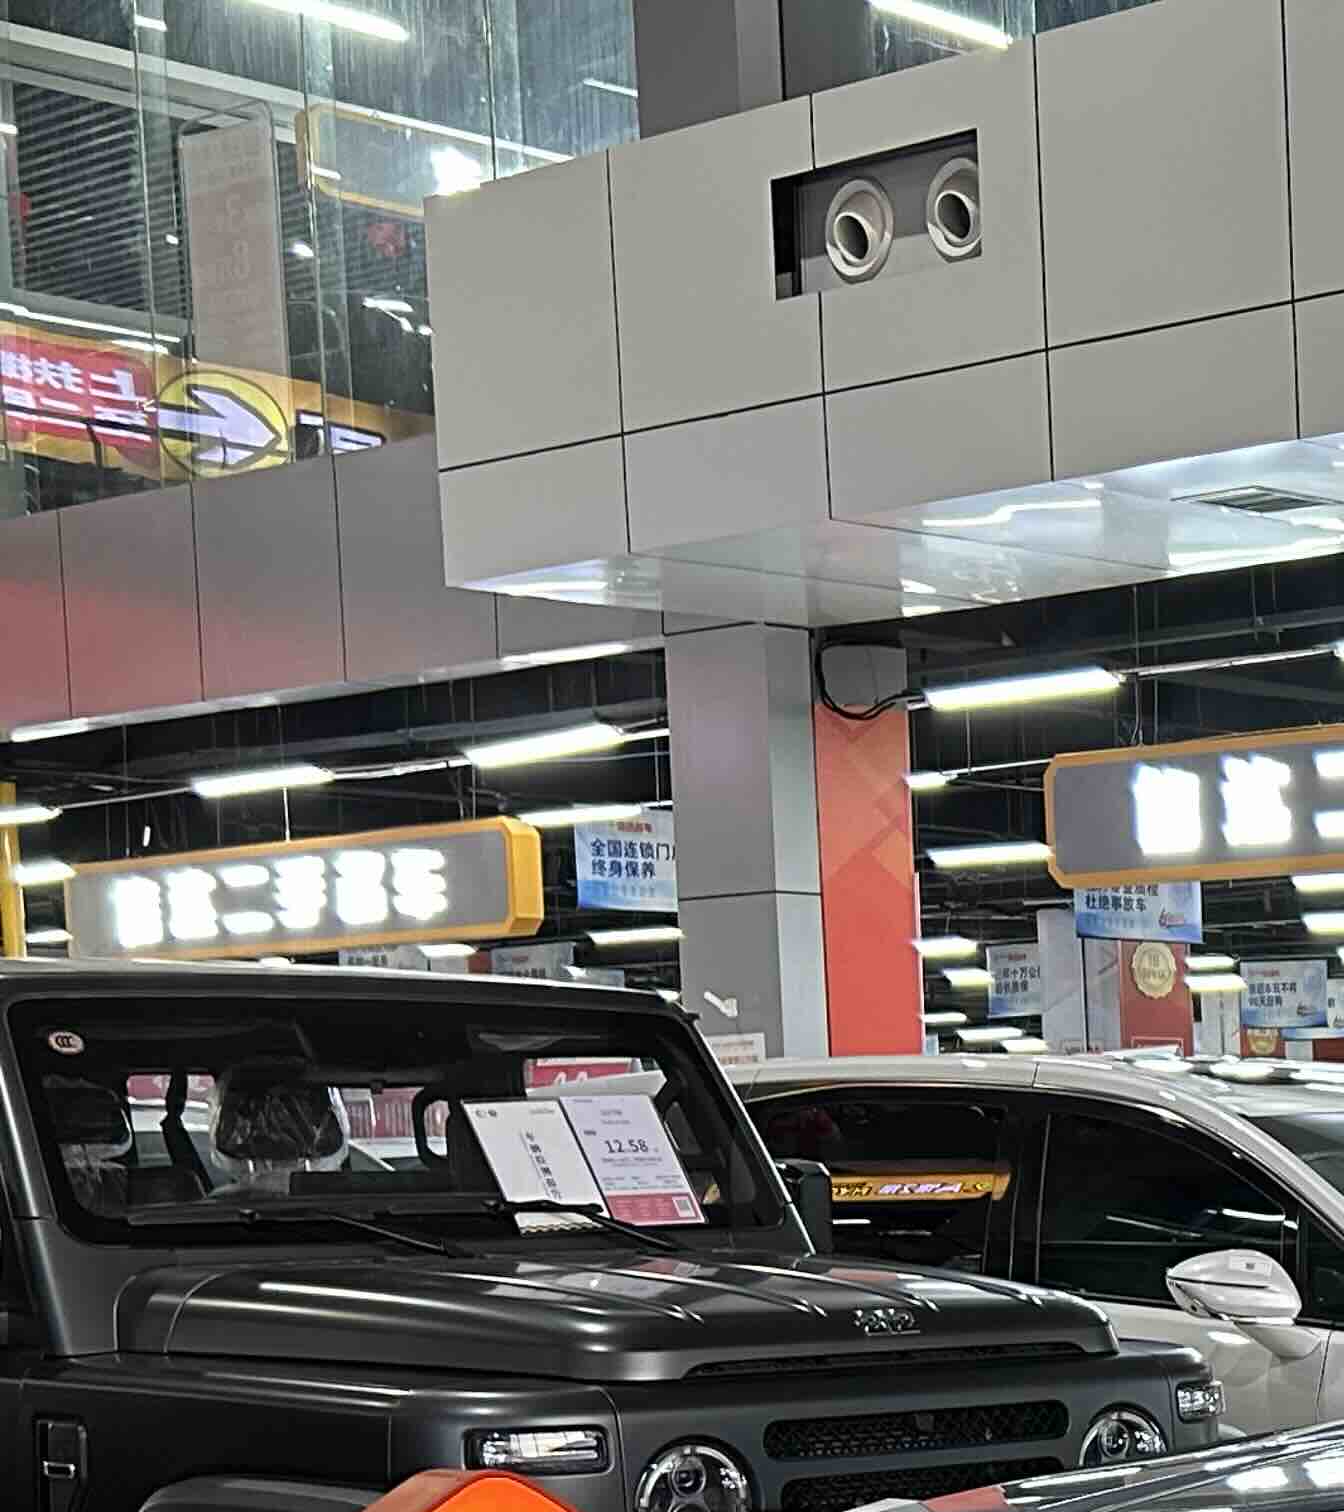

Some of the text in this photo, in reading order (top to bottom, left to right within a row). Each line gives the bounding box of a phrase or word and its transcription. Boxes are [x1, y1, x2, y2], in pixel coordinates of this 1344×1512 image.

[590, 838, 676, 861] 全国连锁门
[591, 860, 656, 879] 终身保养
